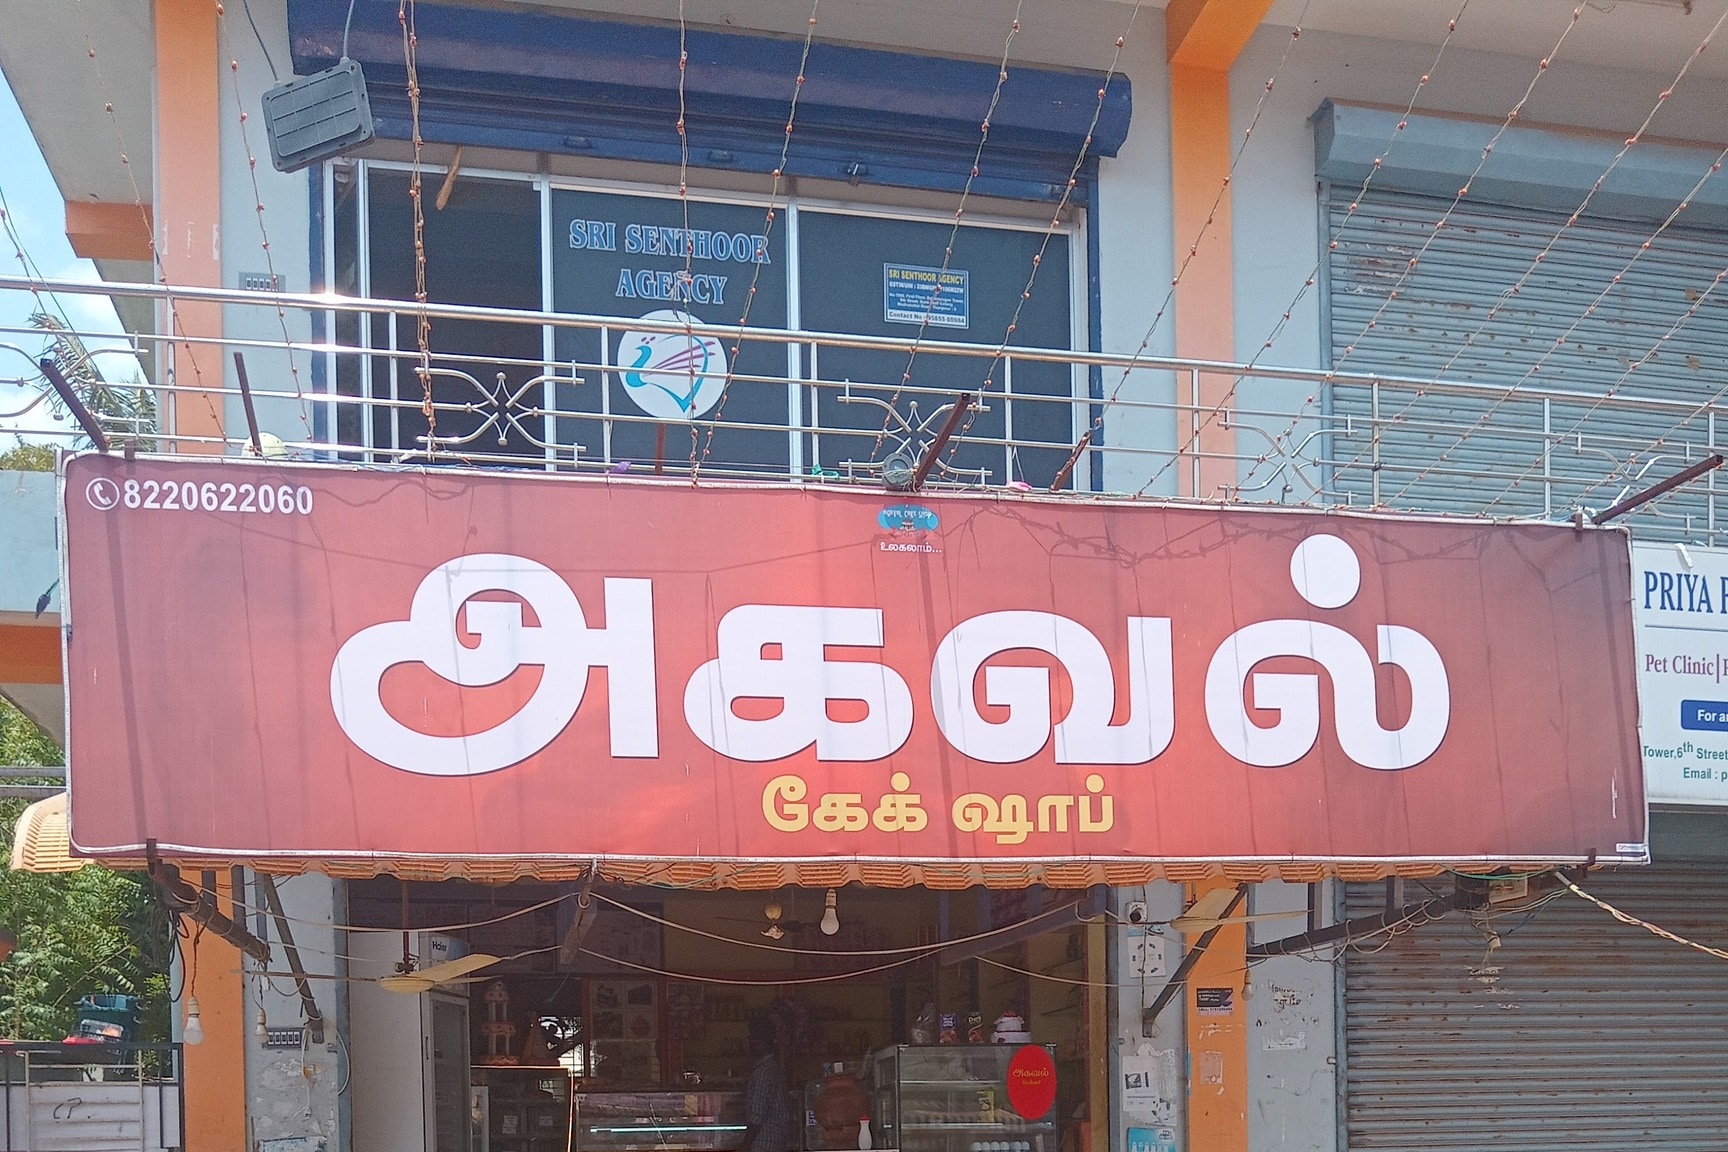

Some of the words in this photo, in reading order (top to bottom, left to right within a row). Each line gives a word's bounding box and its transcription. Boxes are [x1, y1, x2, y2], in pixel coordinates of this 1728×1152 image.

[569, 219, 616, 251] SRI
[625, 224, 771, 264] SENTHOOR
[615, 269, 727, 305] AGENCY
[888, 269, 900, 279] SRI
[901, 270, 937, 283] SENTHOOR
[938, 274, 964, 285] AGENCY
[889, 311, 913, 320] Contact
[124, 479, 314, 515] 8220622060
[1644, 571, 1713, 613] PRIYA
[329, 533, 1451, 777] அகவல்
[1645, 654, 1668, 673] Pet
[1697, 709, 1717, 722] For
[1683, 767, 1712, 779] Email
[762, 771, 928, 832] கேக்
[952, 773, 1114, 845] ஷாப்
